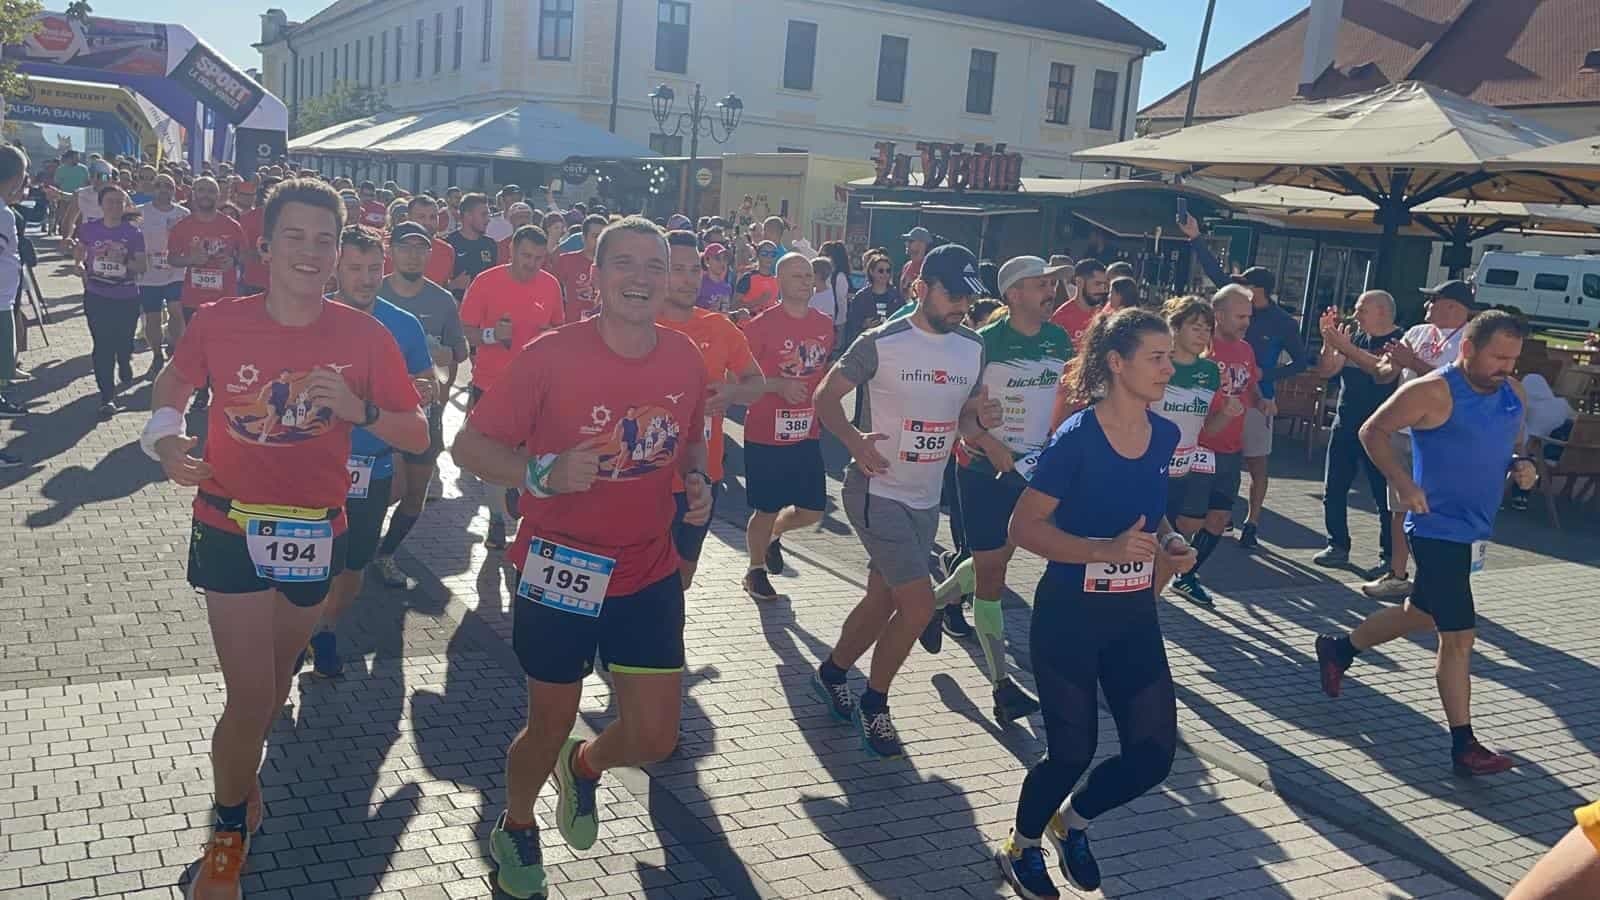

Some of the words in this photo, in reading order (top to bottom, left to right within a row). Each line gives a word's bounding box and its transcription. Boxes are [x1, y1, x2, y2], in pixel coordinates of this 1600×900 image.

[195, 56, 252, 103] SPORT
[7, 104, 50, 116] ALPHA
[53, 109, 91, 120] BANK
[102, 262, 120, 271] 304
[198, 275, 217, 284] 305
[785, 420, 808, 431] 388
[914, 435, 945, 450] 365
[265, 541, 316, 562] 194
[542, 565, 591, 594] 195
